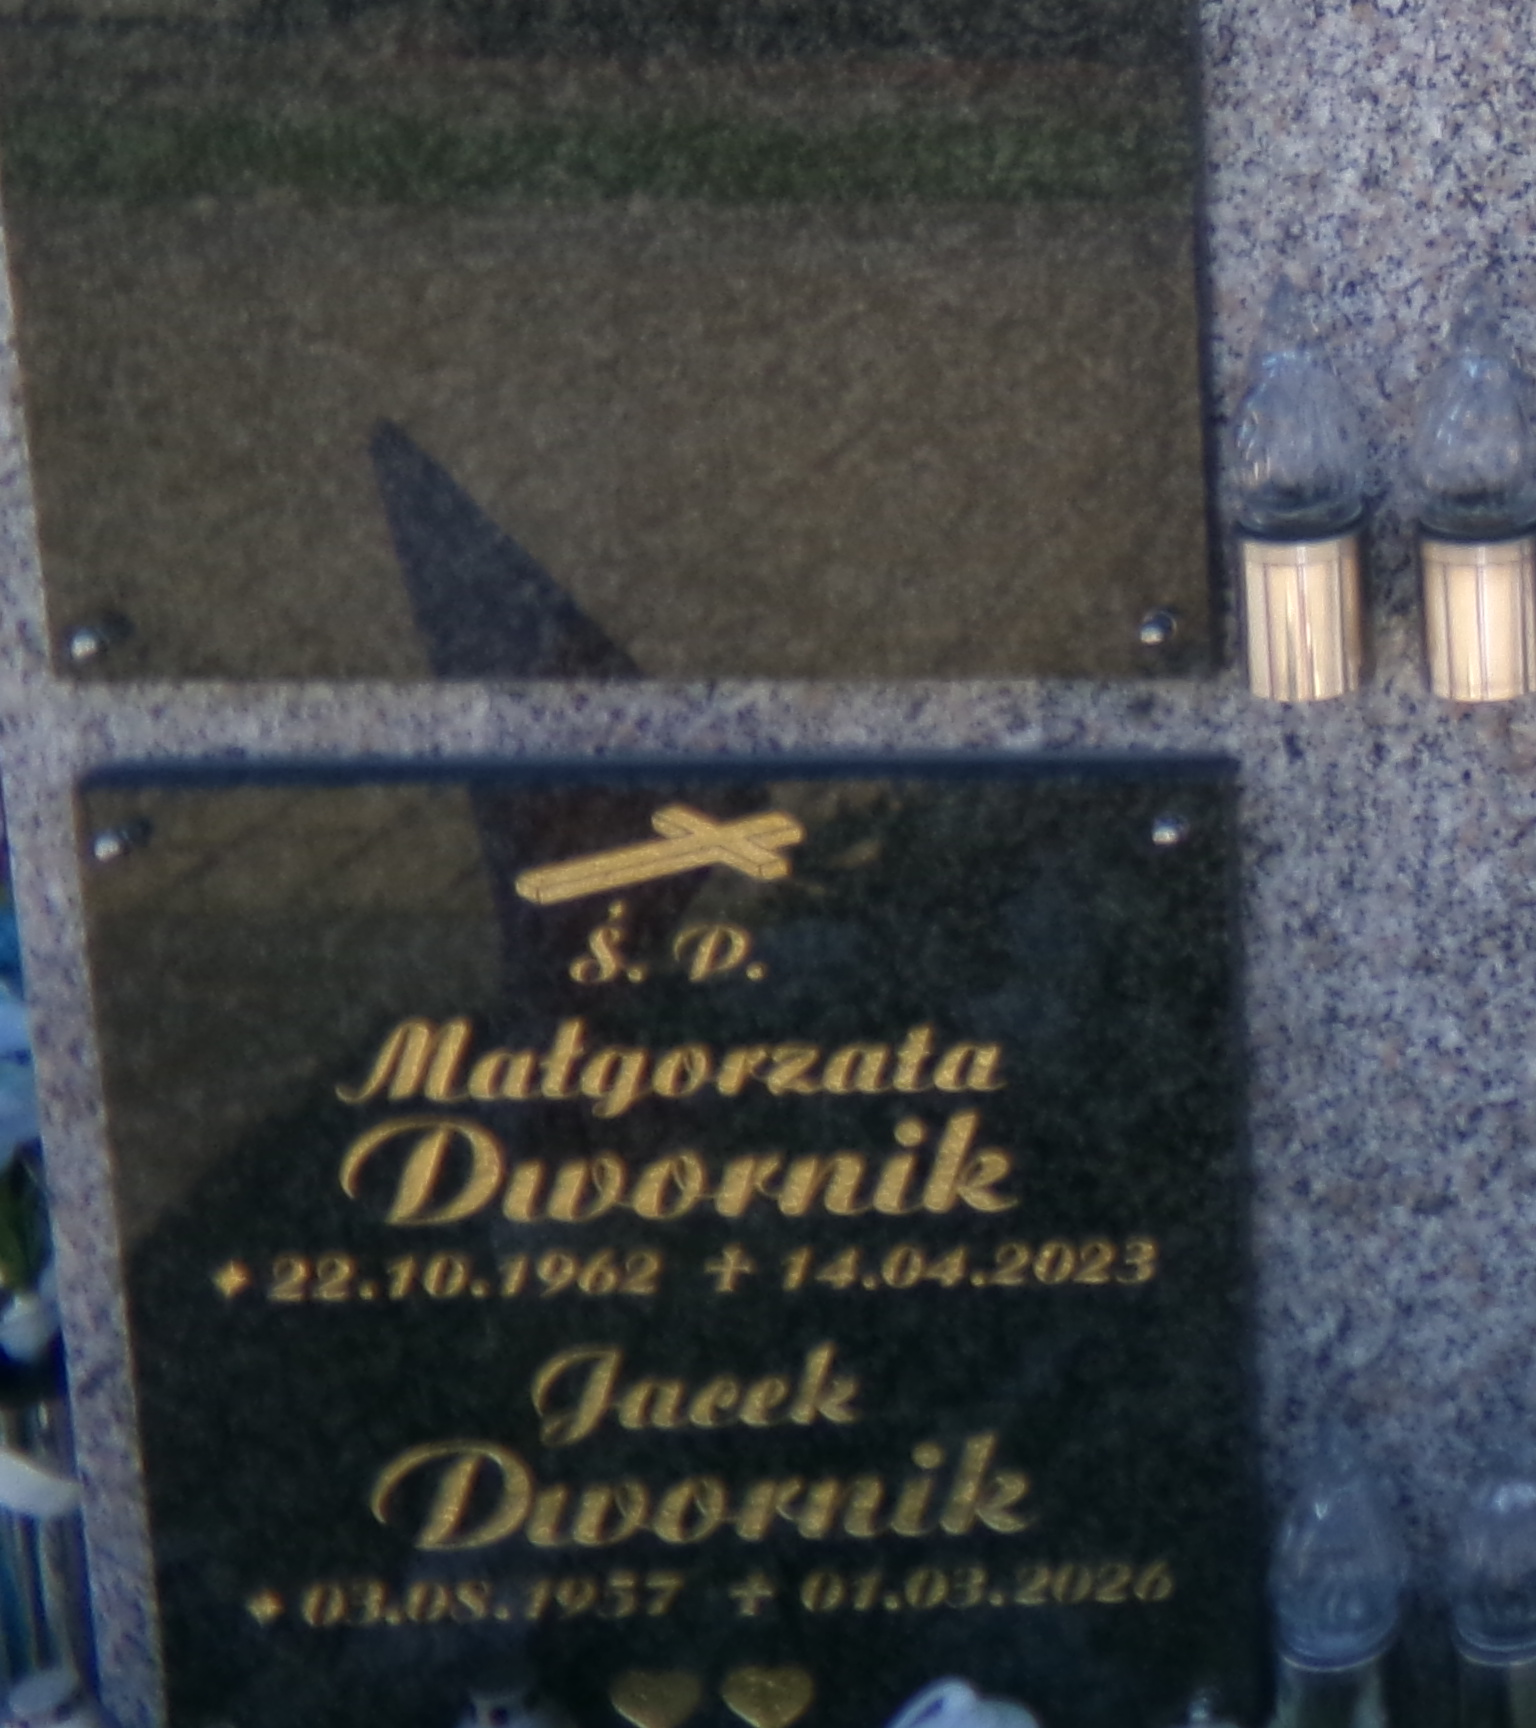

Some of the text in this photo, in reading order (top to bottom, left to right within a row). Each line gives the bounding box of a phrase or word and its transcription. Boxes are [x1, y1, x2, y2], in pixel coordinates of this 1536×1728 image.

[568, 900, 767, 984] Ś. P.
[335, 1017, 1009, 1119] Małgorzata
[338, 1110, 1021, 1226] Dwornik
[267, 1236, 1158, 1302] 22.10.1962 14.04.2023
[530, 1340, 860, 1446] Jacek
[369, 1432, 1035, 1551] Dwornik
